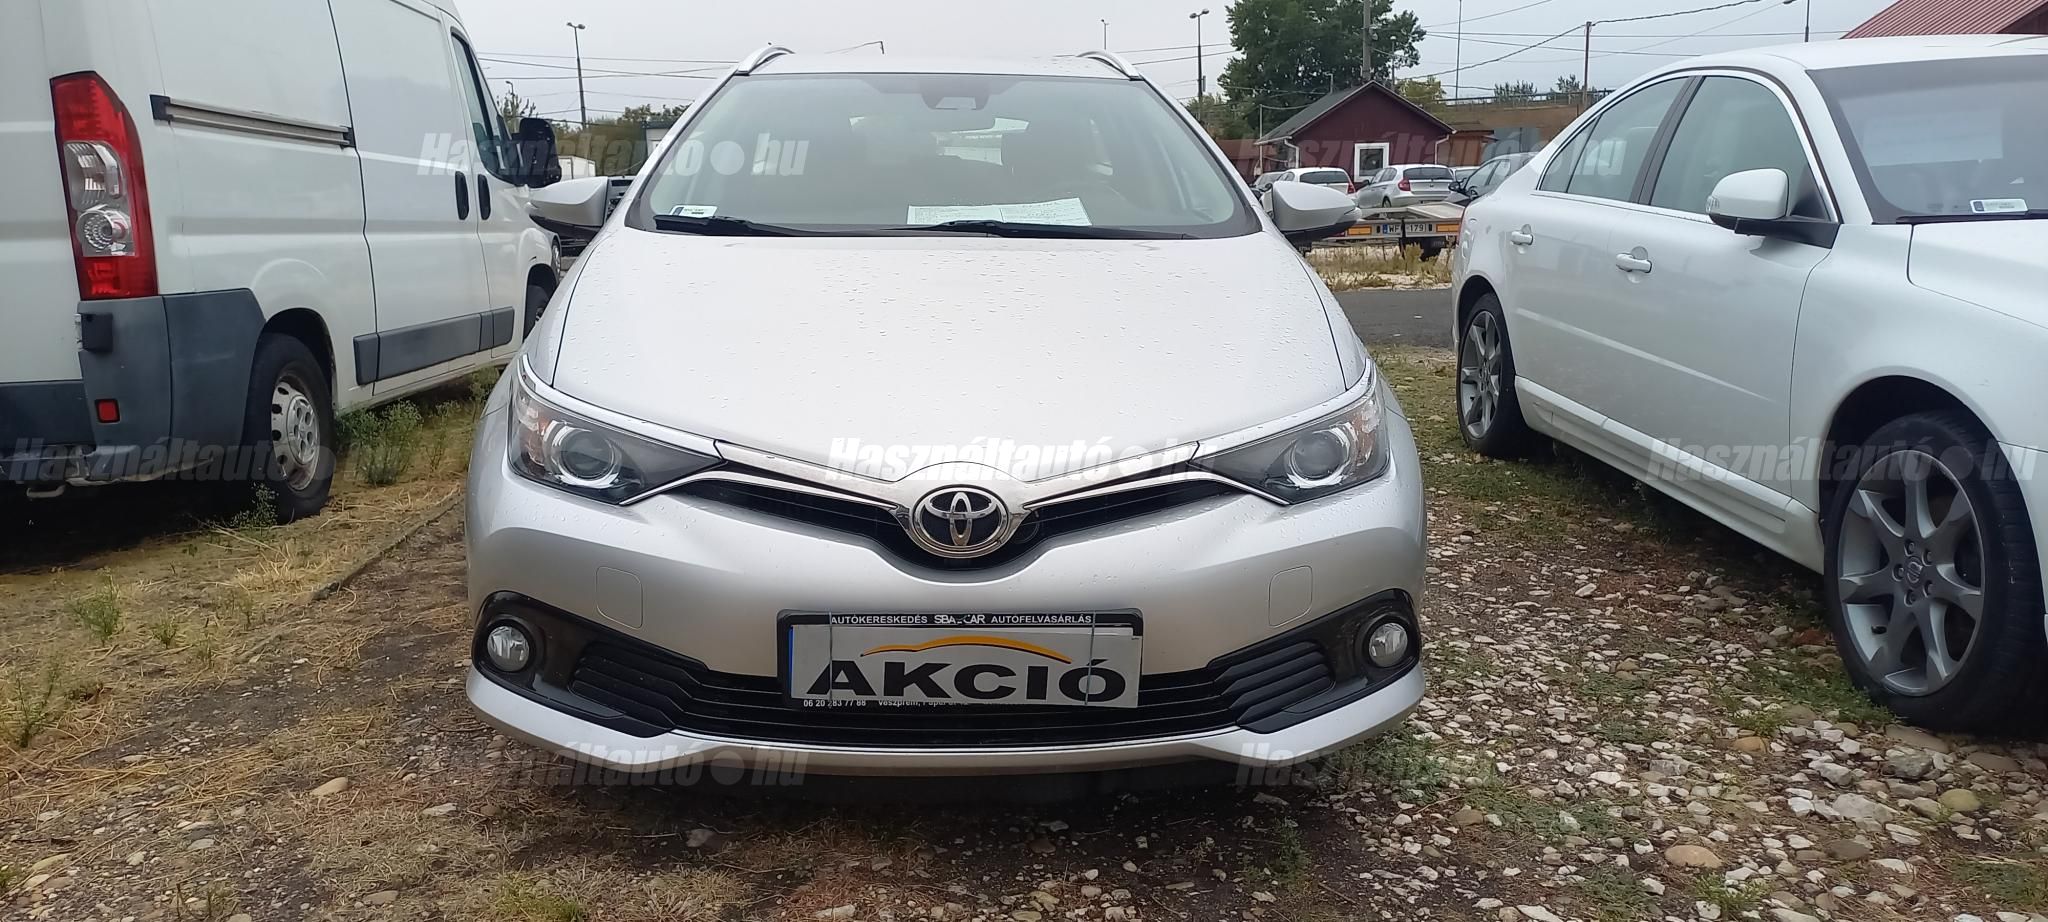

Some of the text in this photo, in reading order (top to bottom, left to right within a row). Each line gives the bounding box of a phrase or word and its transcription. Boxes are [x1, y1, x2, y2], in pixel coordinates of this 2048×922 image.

[831, 614, 928, 625] AUTÓKERESKEDÉS
[991, 614, 1092, 624] AUTÓFELVÁSÁRLÁS
[806, 658, 1127, 703] AKCIÓ
